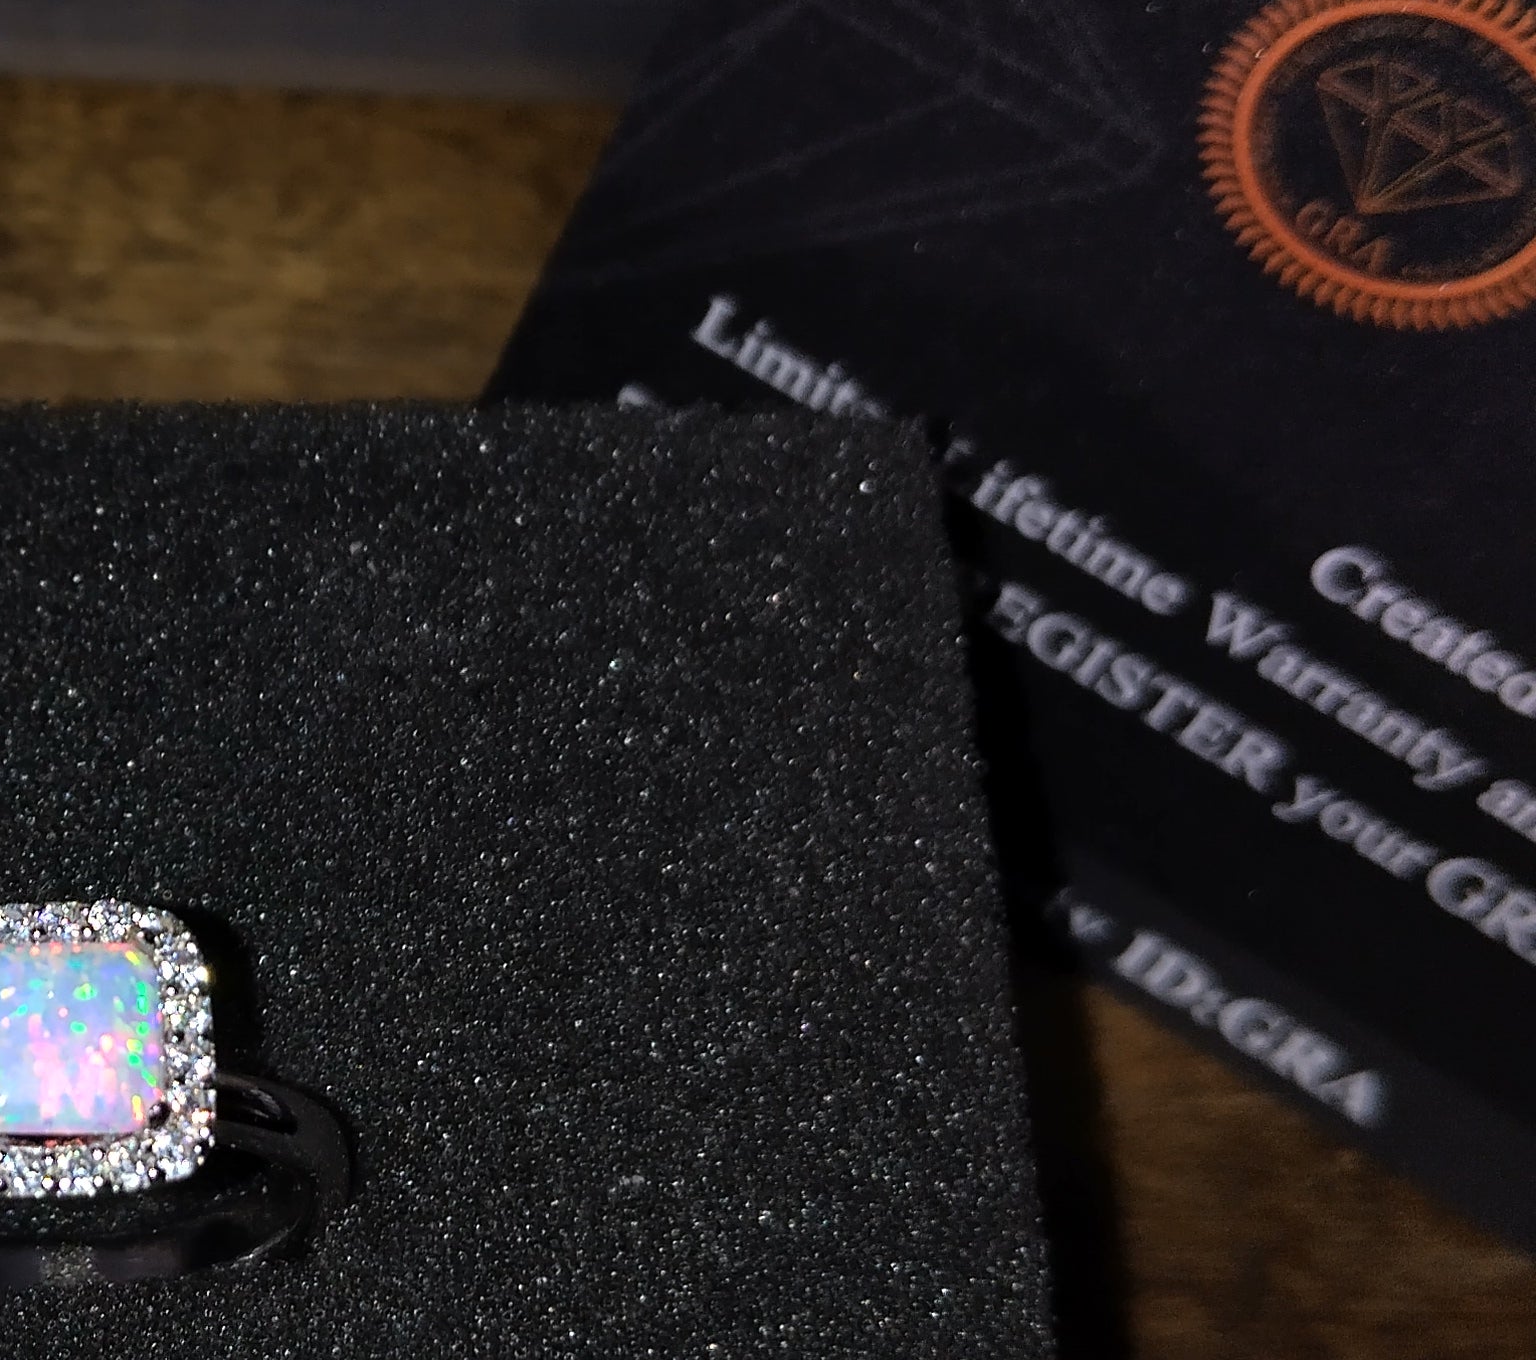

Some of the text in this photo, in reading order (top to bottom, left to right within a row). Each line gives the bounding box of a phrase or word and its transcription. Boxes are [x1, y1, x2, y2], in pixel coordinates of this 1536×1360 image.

[944, 437, 1193, 616] ifetime
[1205, 591, 1487, 791] Warranty
[986, 582, 1290, 796] EGISTER
[1271, 774, 1440, 879] your
[1113, 929, 1387, 1129] ID:GRA
